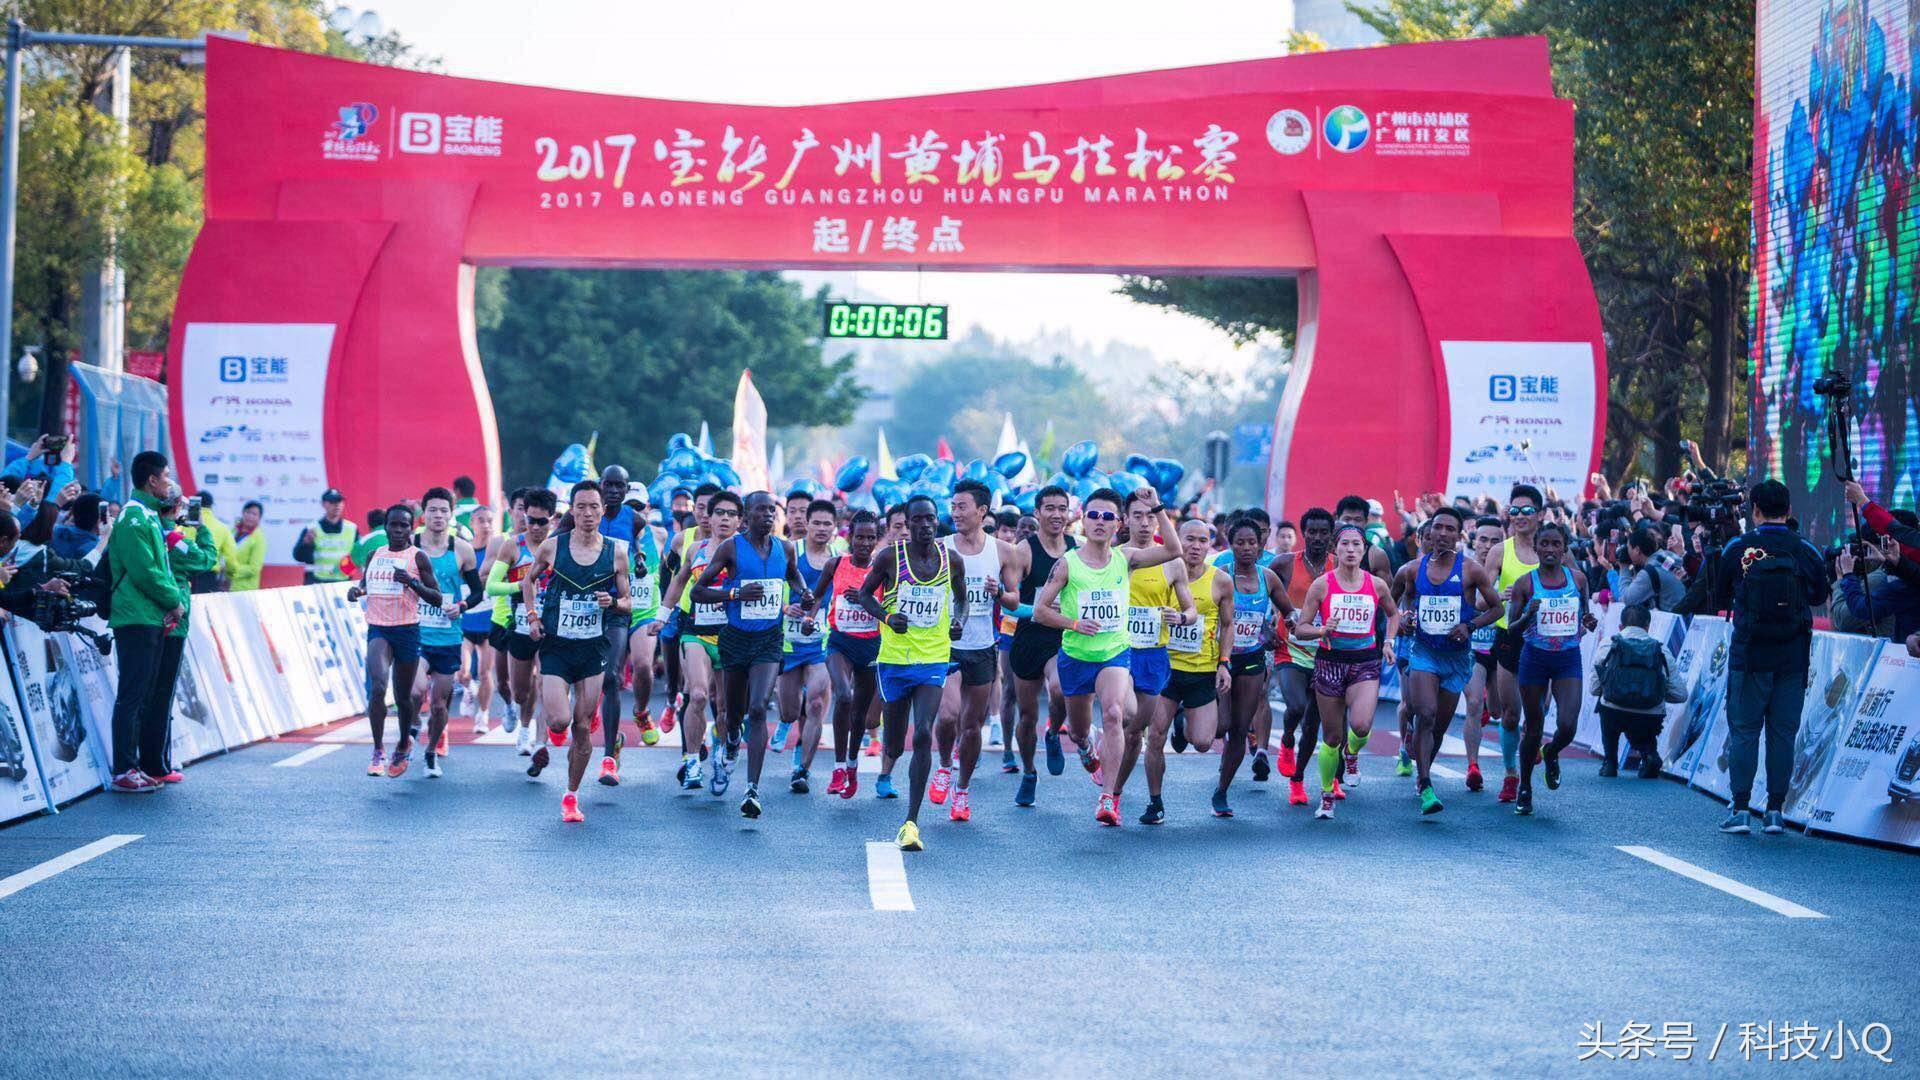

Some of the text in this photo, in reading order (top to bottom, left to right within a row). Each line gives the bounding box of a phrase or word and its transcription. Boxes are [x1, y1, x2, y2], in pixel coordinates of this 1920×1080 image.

[444, 115, 503, 144] 宝能
[444, 144, 502, 157] BAONENG
[535, 133, 637, 189] 2017
[540, 184, 1229, 208] 2017 BAONENG GUANGZHOU HUANGPU MARATHON
[813, 216, 966, 254] 起/终点
[829, 305, 944, 338] 0:00:06
[251, 357, 288, 375] 宝能
[1520, 375, 1558, 394] 宝能
[1515, 416, 1562, 425] HONDA
[368, 570, 394, 582] A444
[967, 590, 990, 604] 019
[417, 604, 448, 617] ZT00
[900, 599, 939, 616] ZT044
[1081, 604, 1120, 620] ZT001
[1333, 606, 1369, 621] ZT056
[561, 613, 597, 628] ZT050
[1421, 609, 1456, 623] ZT035
[1540, 610, 1577, 625] ZT064
[788, 620, 821, 633] ZT3
